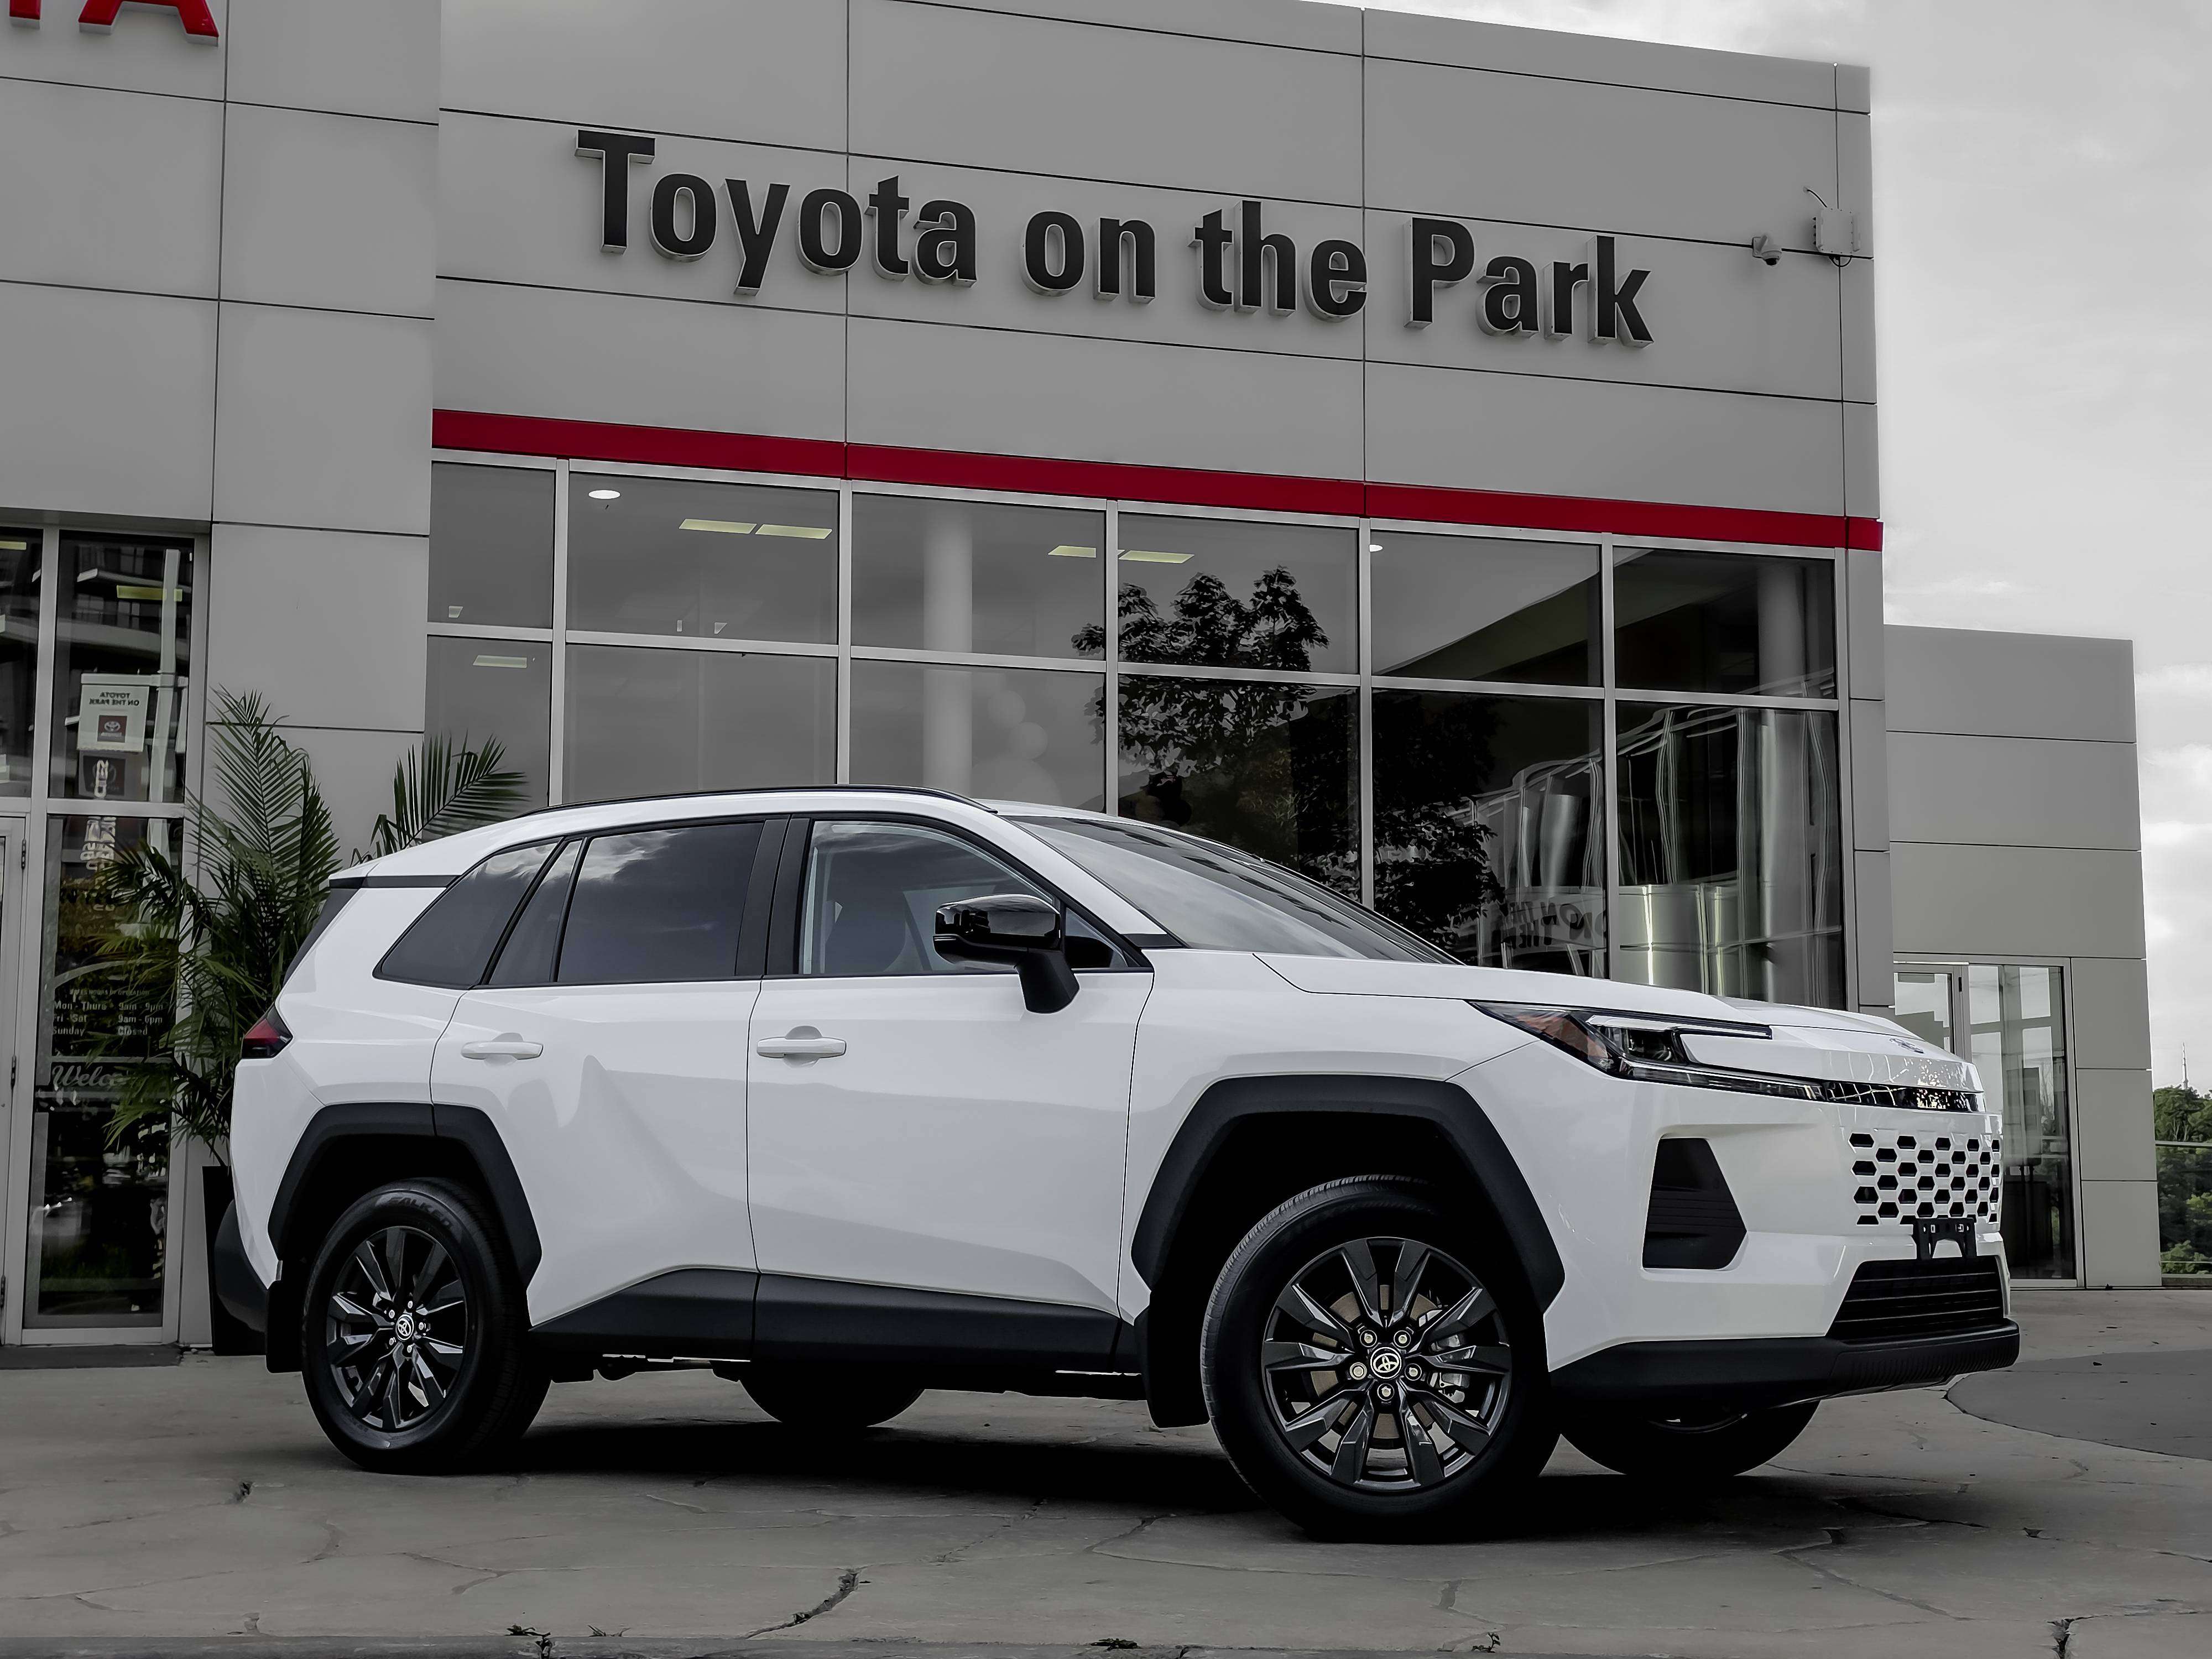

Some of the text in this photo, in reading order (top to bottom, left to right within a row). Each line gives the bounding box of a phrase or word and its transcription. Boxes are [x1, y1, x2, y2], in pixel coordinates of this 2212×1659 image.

[576, 129, 1654, 348] Toyota on the Park
[54, 1000, 72, 1010] Mon
[118, 1014, 137, 1023] 9am
[53, 1025, 85, 1037] Sunday
